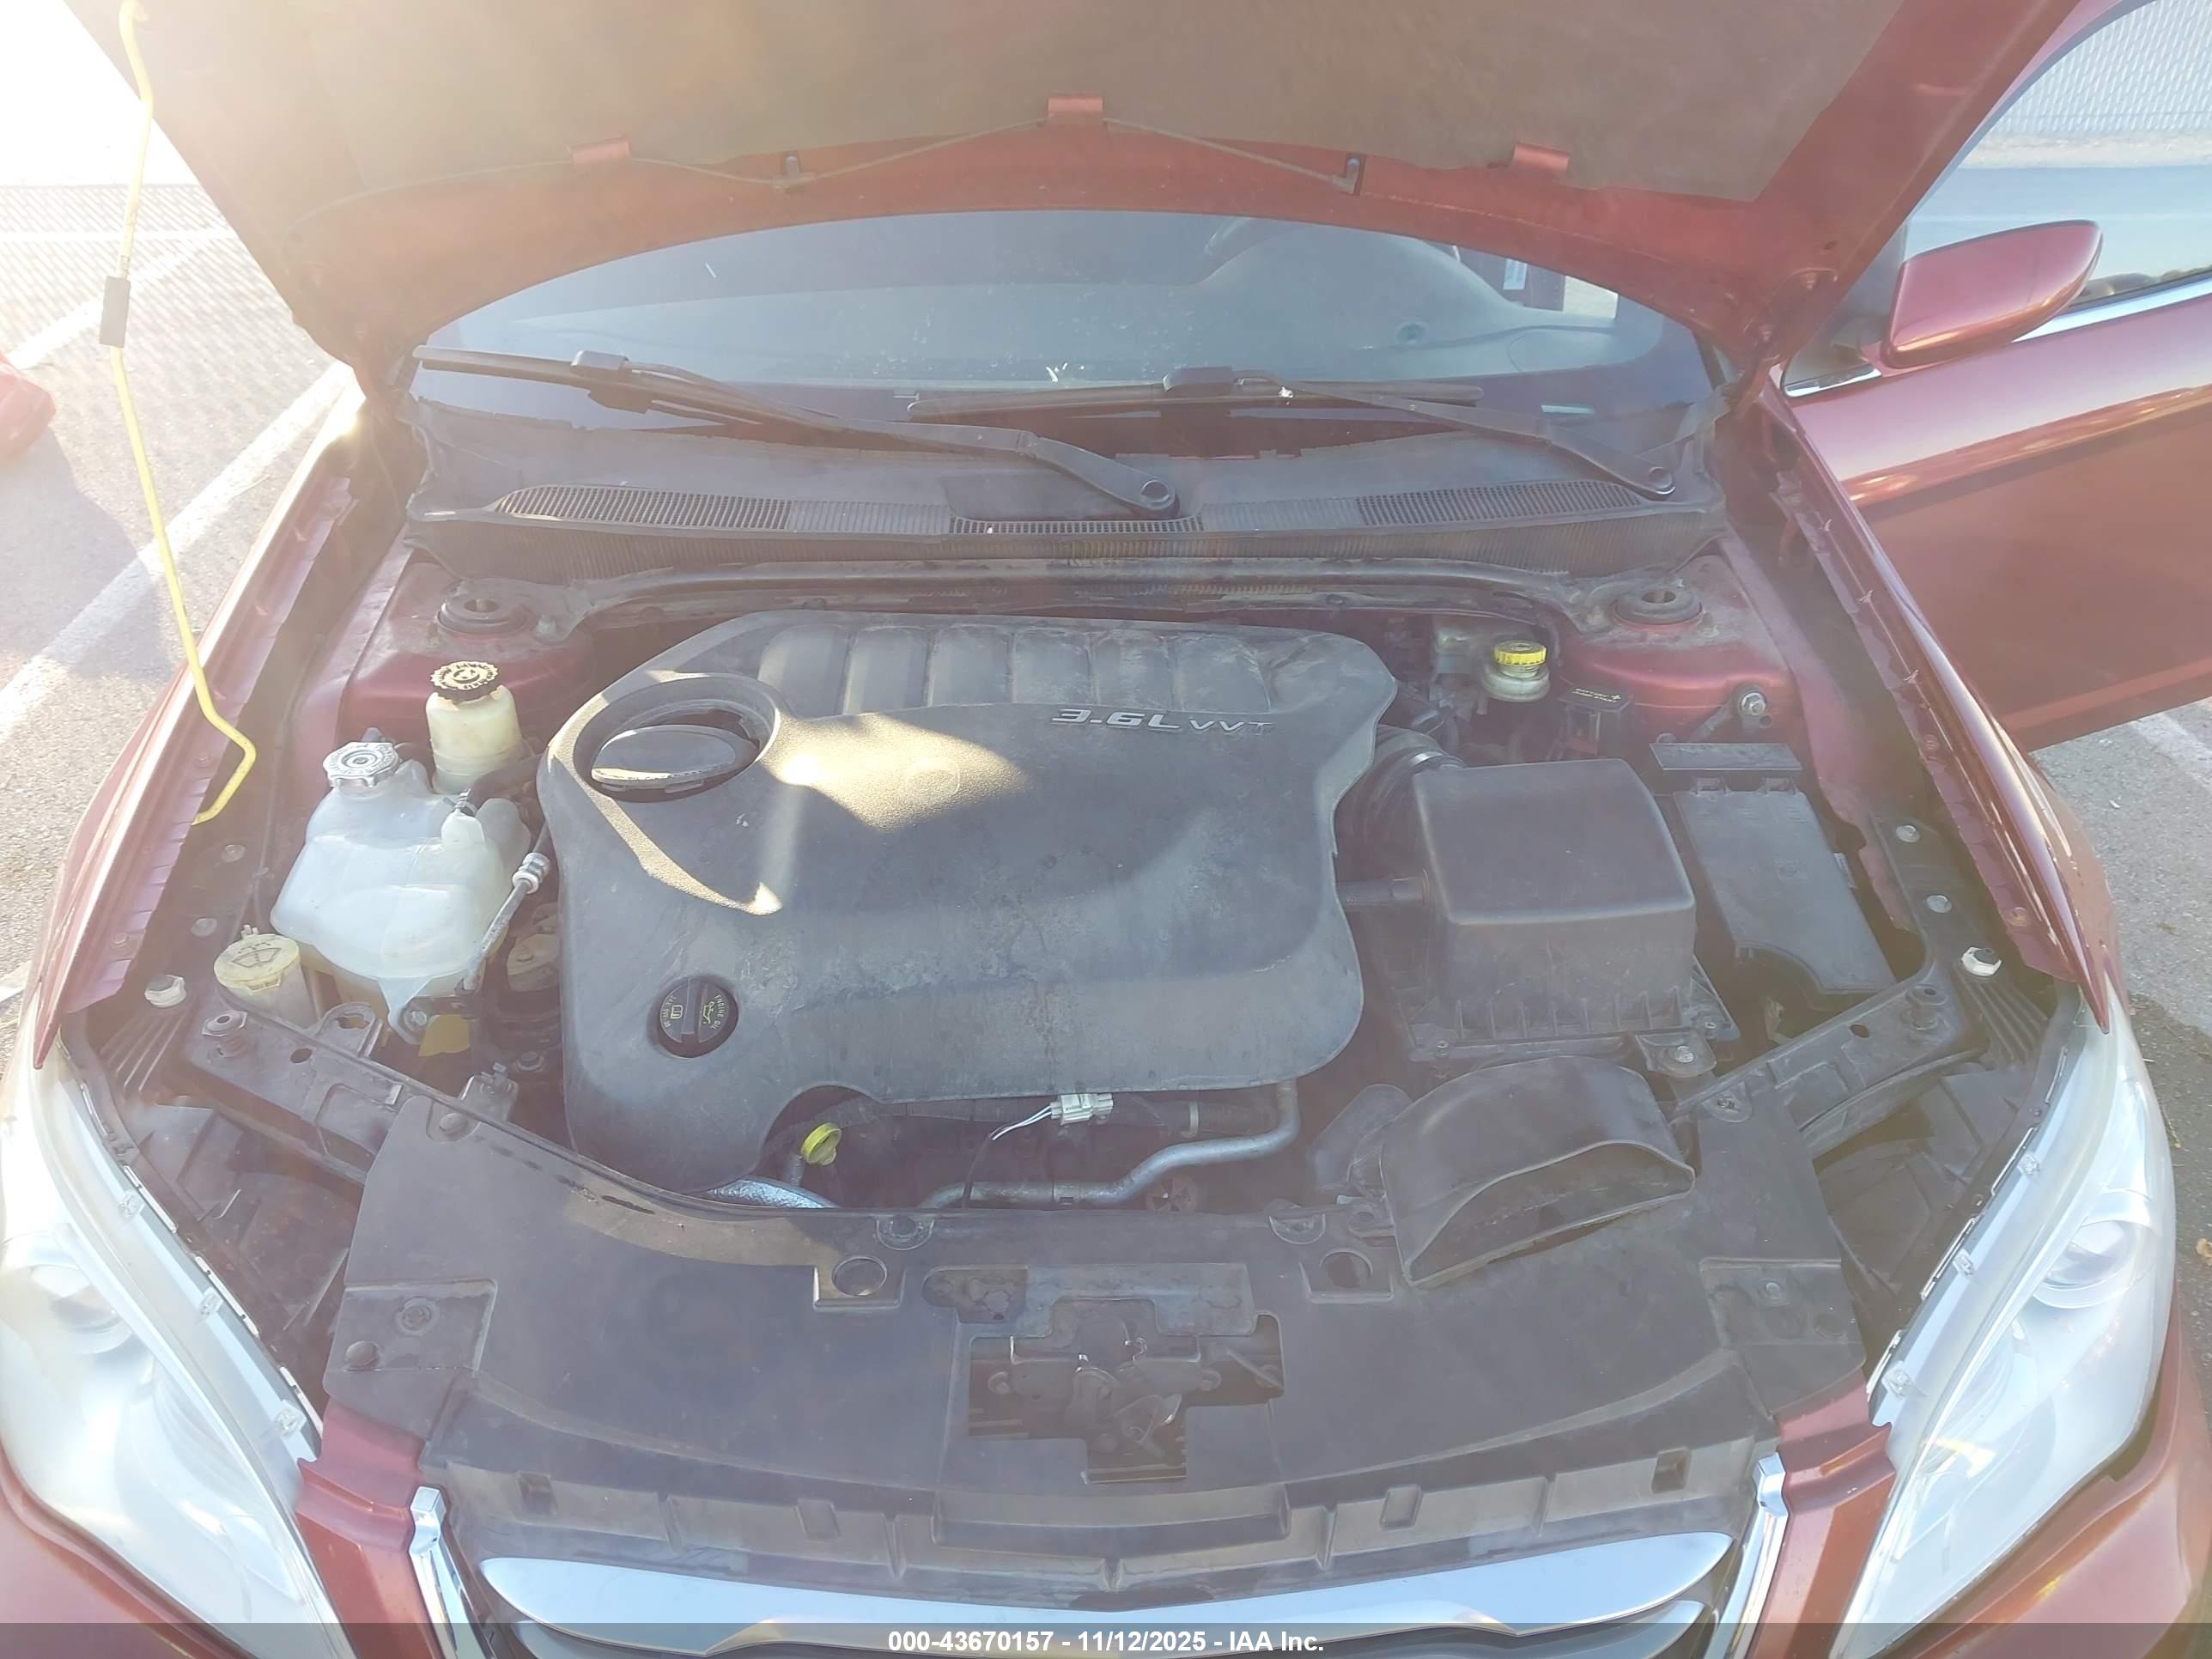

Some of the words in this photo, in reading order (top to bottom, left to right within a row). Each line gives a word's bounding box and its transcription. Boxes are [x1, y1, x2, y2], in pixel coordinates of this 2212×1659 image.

[1050, 708, 1181, 730] 3.6L
[1188, 719, 1273, 736] VVT
[714, 994, 725, 1018] ENGINE
[710, 1020, 721, 1030] OIL
